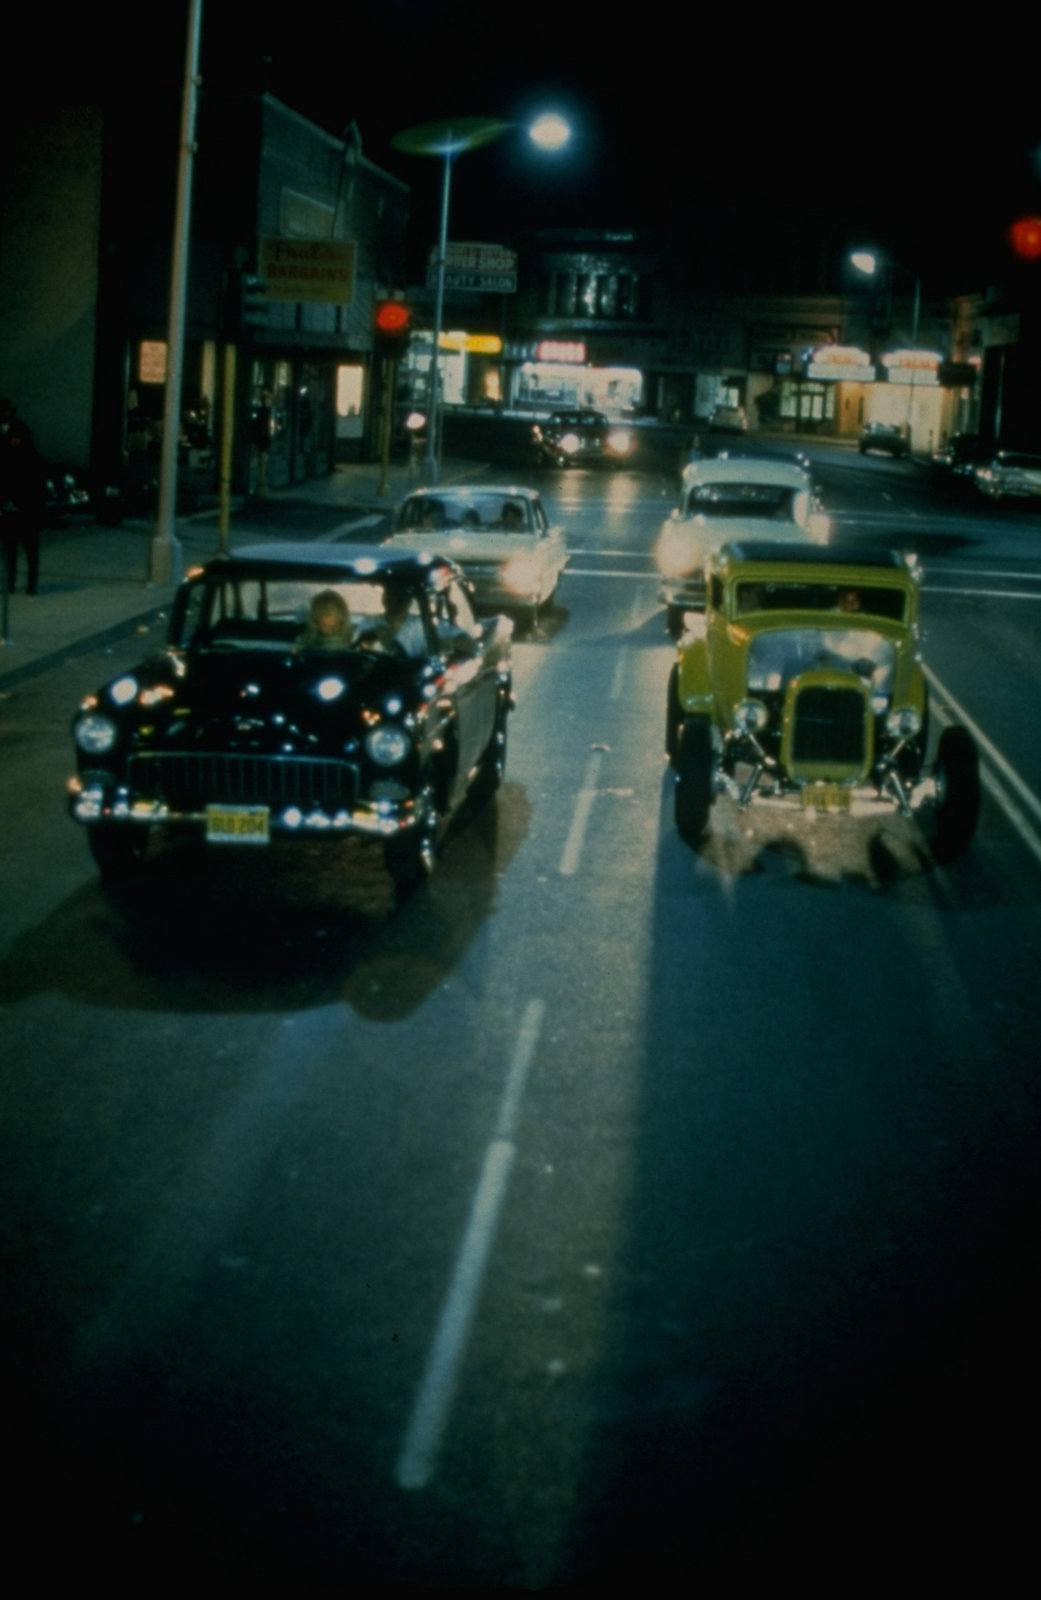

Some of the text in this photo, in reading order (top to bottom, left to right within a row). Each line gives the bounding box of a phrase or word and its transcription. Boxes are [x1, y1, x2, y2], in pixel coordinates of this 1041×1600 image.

[429, 252, 515, 271] BRBER SHOP
[266, 264, 349, 282] BARGAINS
[431, 274, 513, 289] BAUTY SALON
